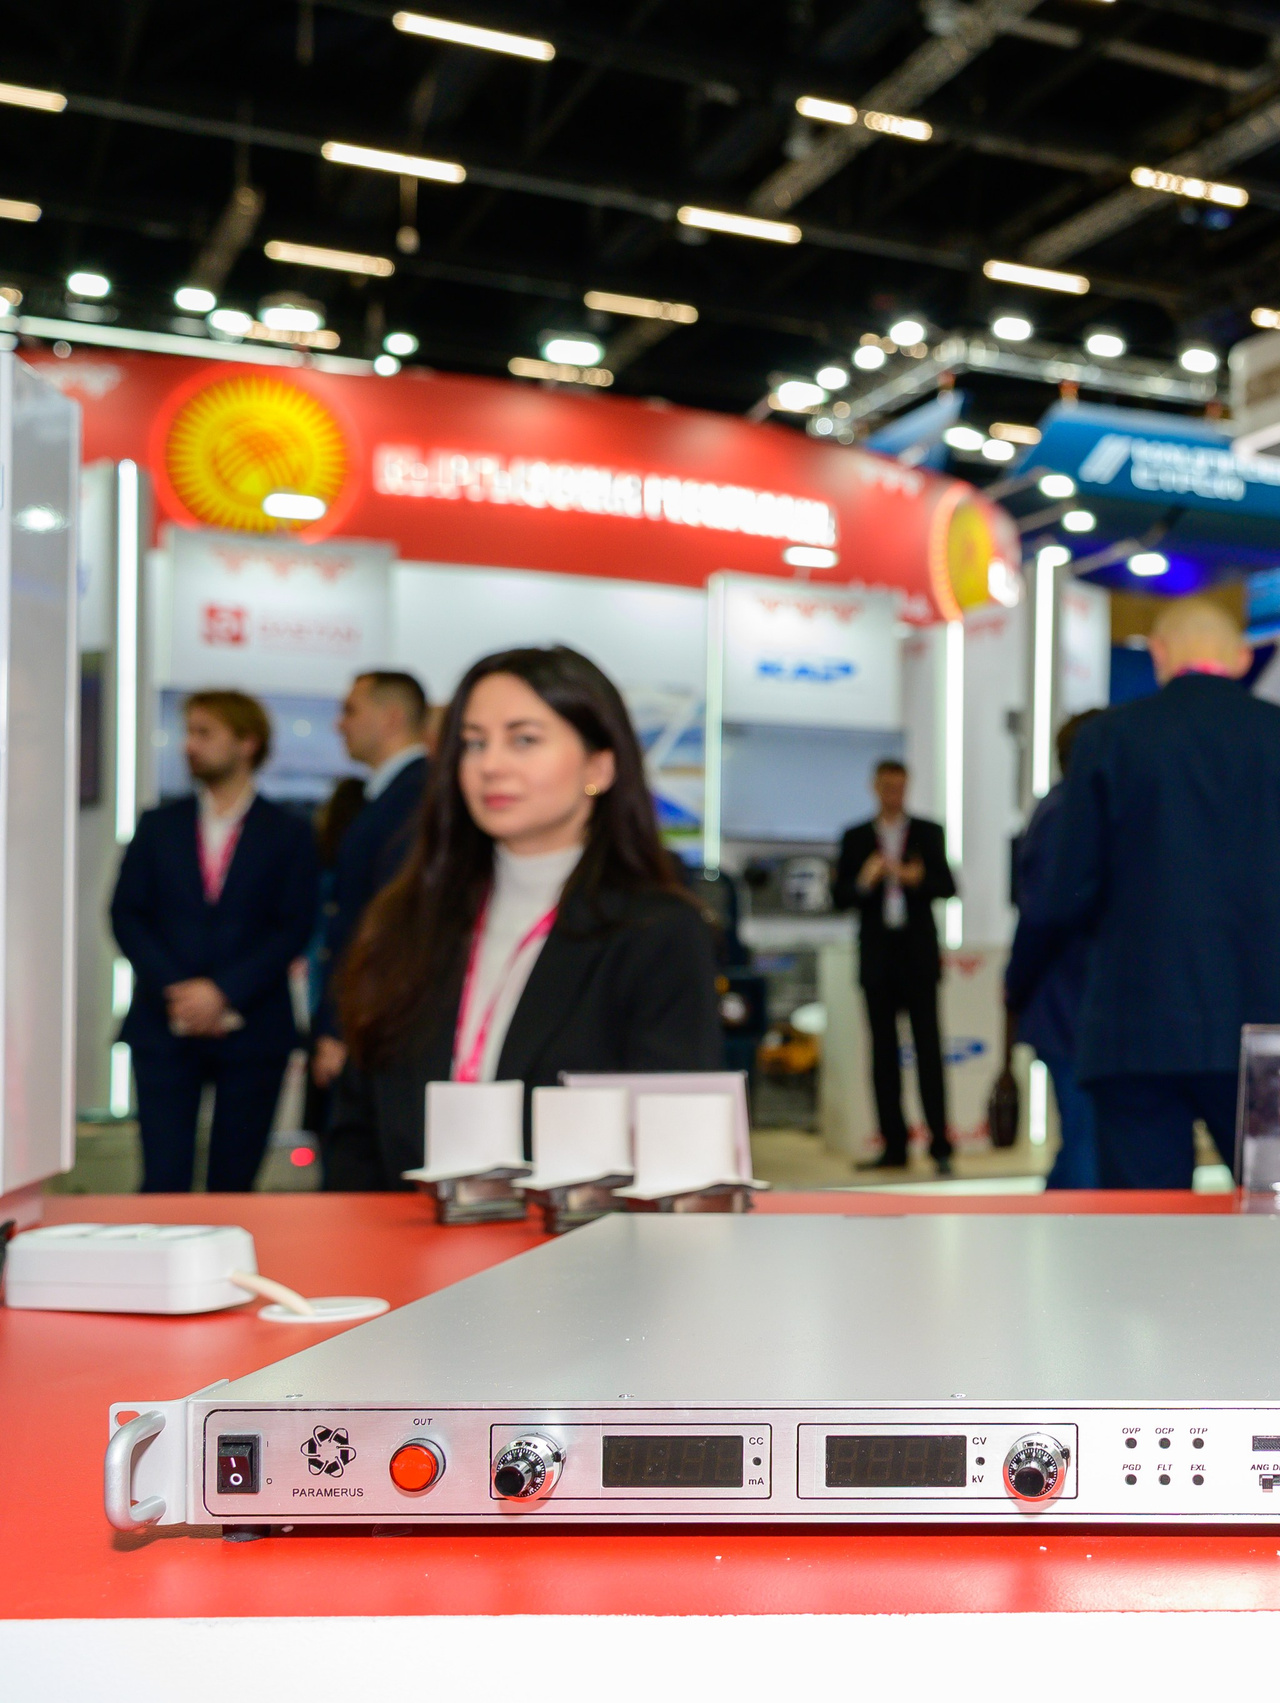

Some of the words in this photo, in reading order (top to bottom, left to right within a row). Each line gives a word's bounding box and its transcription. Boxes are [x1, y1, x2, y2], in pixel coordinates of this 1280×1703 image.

[412, 1418, 433, 1426] OUT
[1121, 1427, 1141, 1435] OVP
[1154, 1427, 1175, 1435] OCP
[1189, 1427, 1208, 1435] OTP
[748, 1437, 764, 1446] CC
[971, 1437, 987, 1446] CV
[748, 1477, 765, 1486] mA
[971, 1475, 985, 1483] kV
[292, 1487, 364, 1498] PARAMERUS
